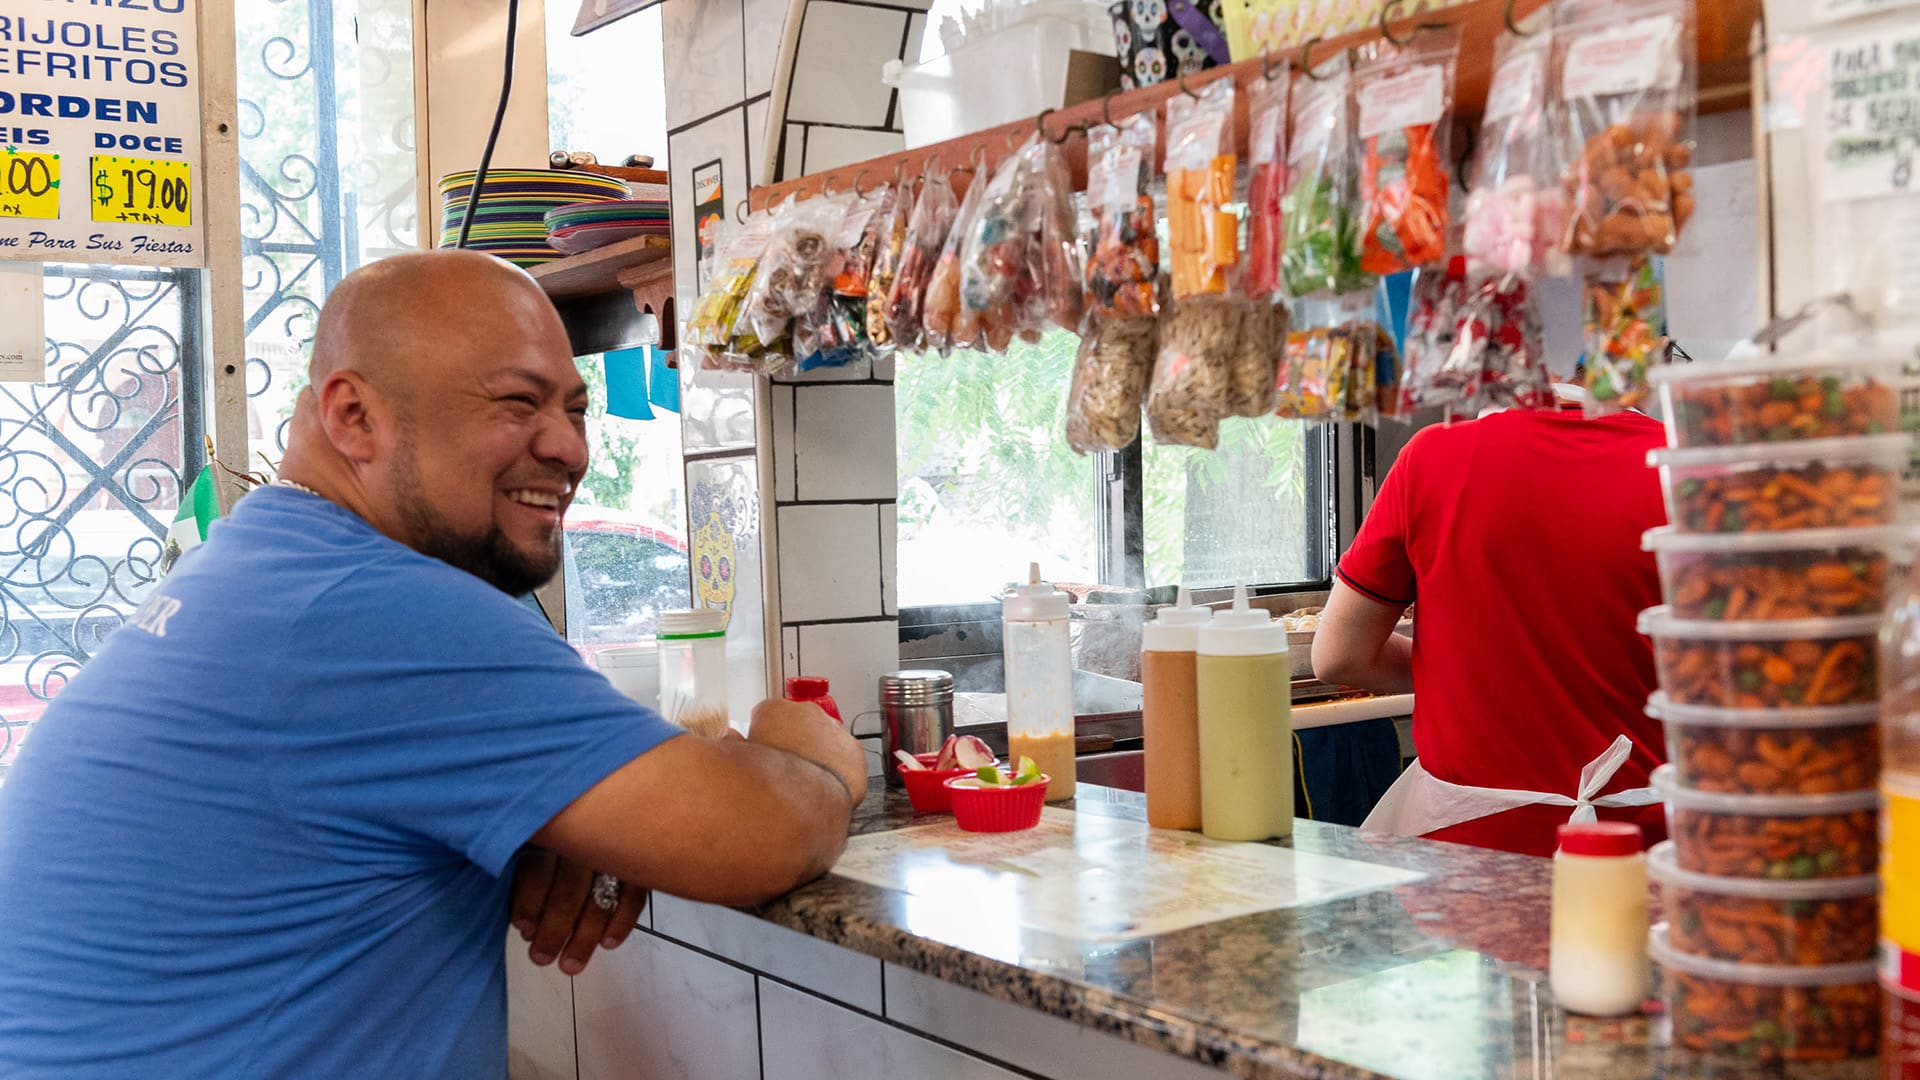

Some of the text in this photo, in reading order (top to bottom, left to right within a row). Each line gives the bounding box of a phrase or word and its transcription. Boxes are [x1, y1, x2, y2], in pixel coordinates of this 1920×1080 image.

[95, 132, 183, 153] DOCE
[28, 231, 77, 249] Para
[86, 234, 124, 250] Sus
[130, 235, 195, 254] Fiestas
